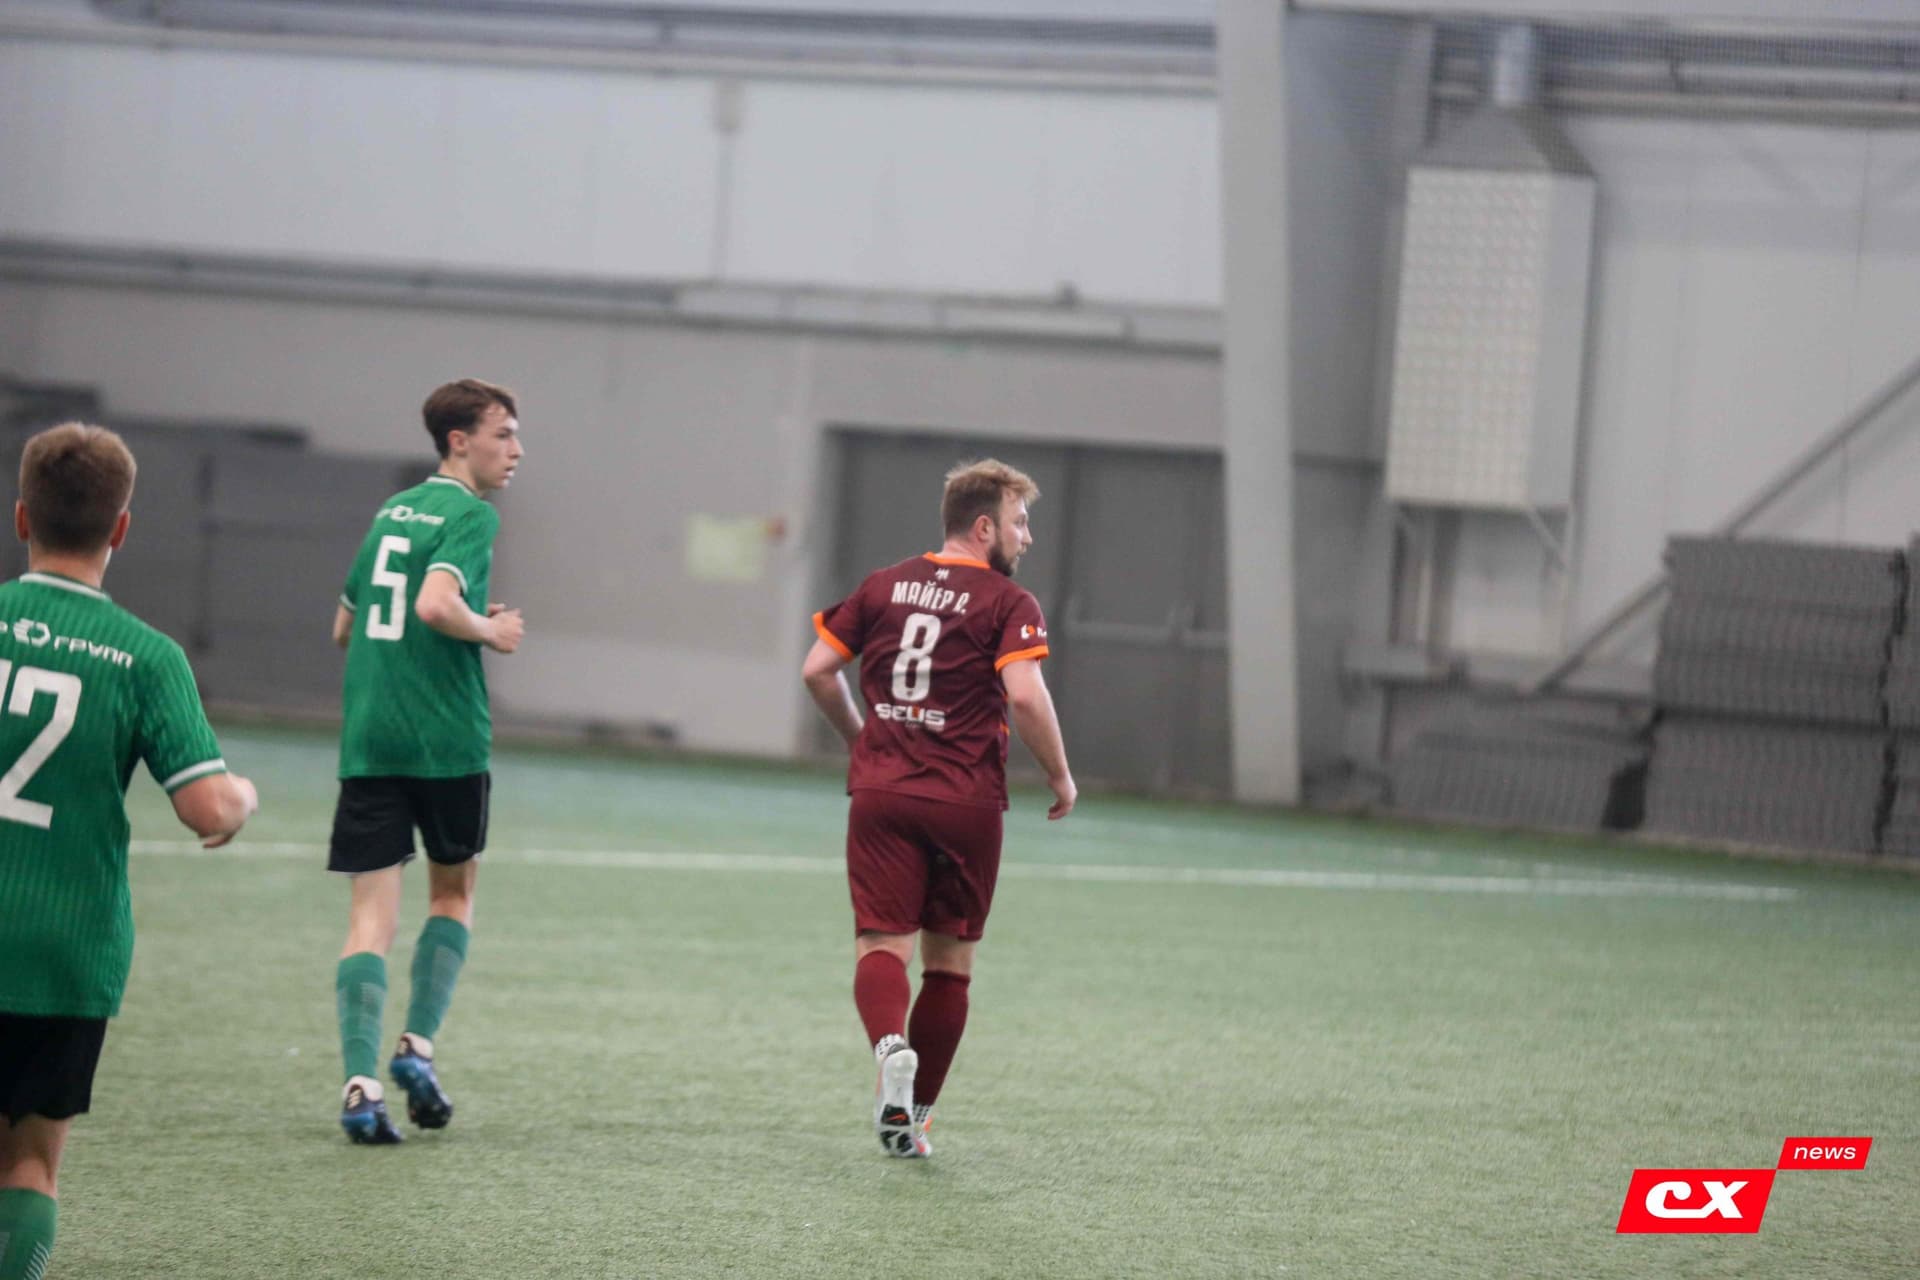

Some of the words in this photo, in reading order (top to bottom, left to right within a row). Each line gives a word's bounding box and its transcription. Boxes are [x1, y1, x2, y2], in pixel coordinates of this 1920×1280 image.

[365, 535, 411, 641] 5
[891, 580, 955, 611] МАЙЕР
[891, 612, 941, 702] 8
